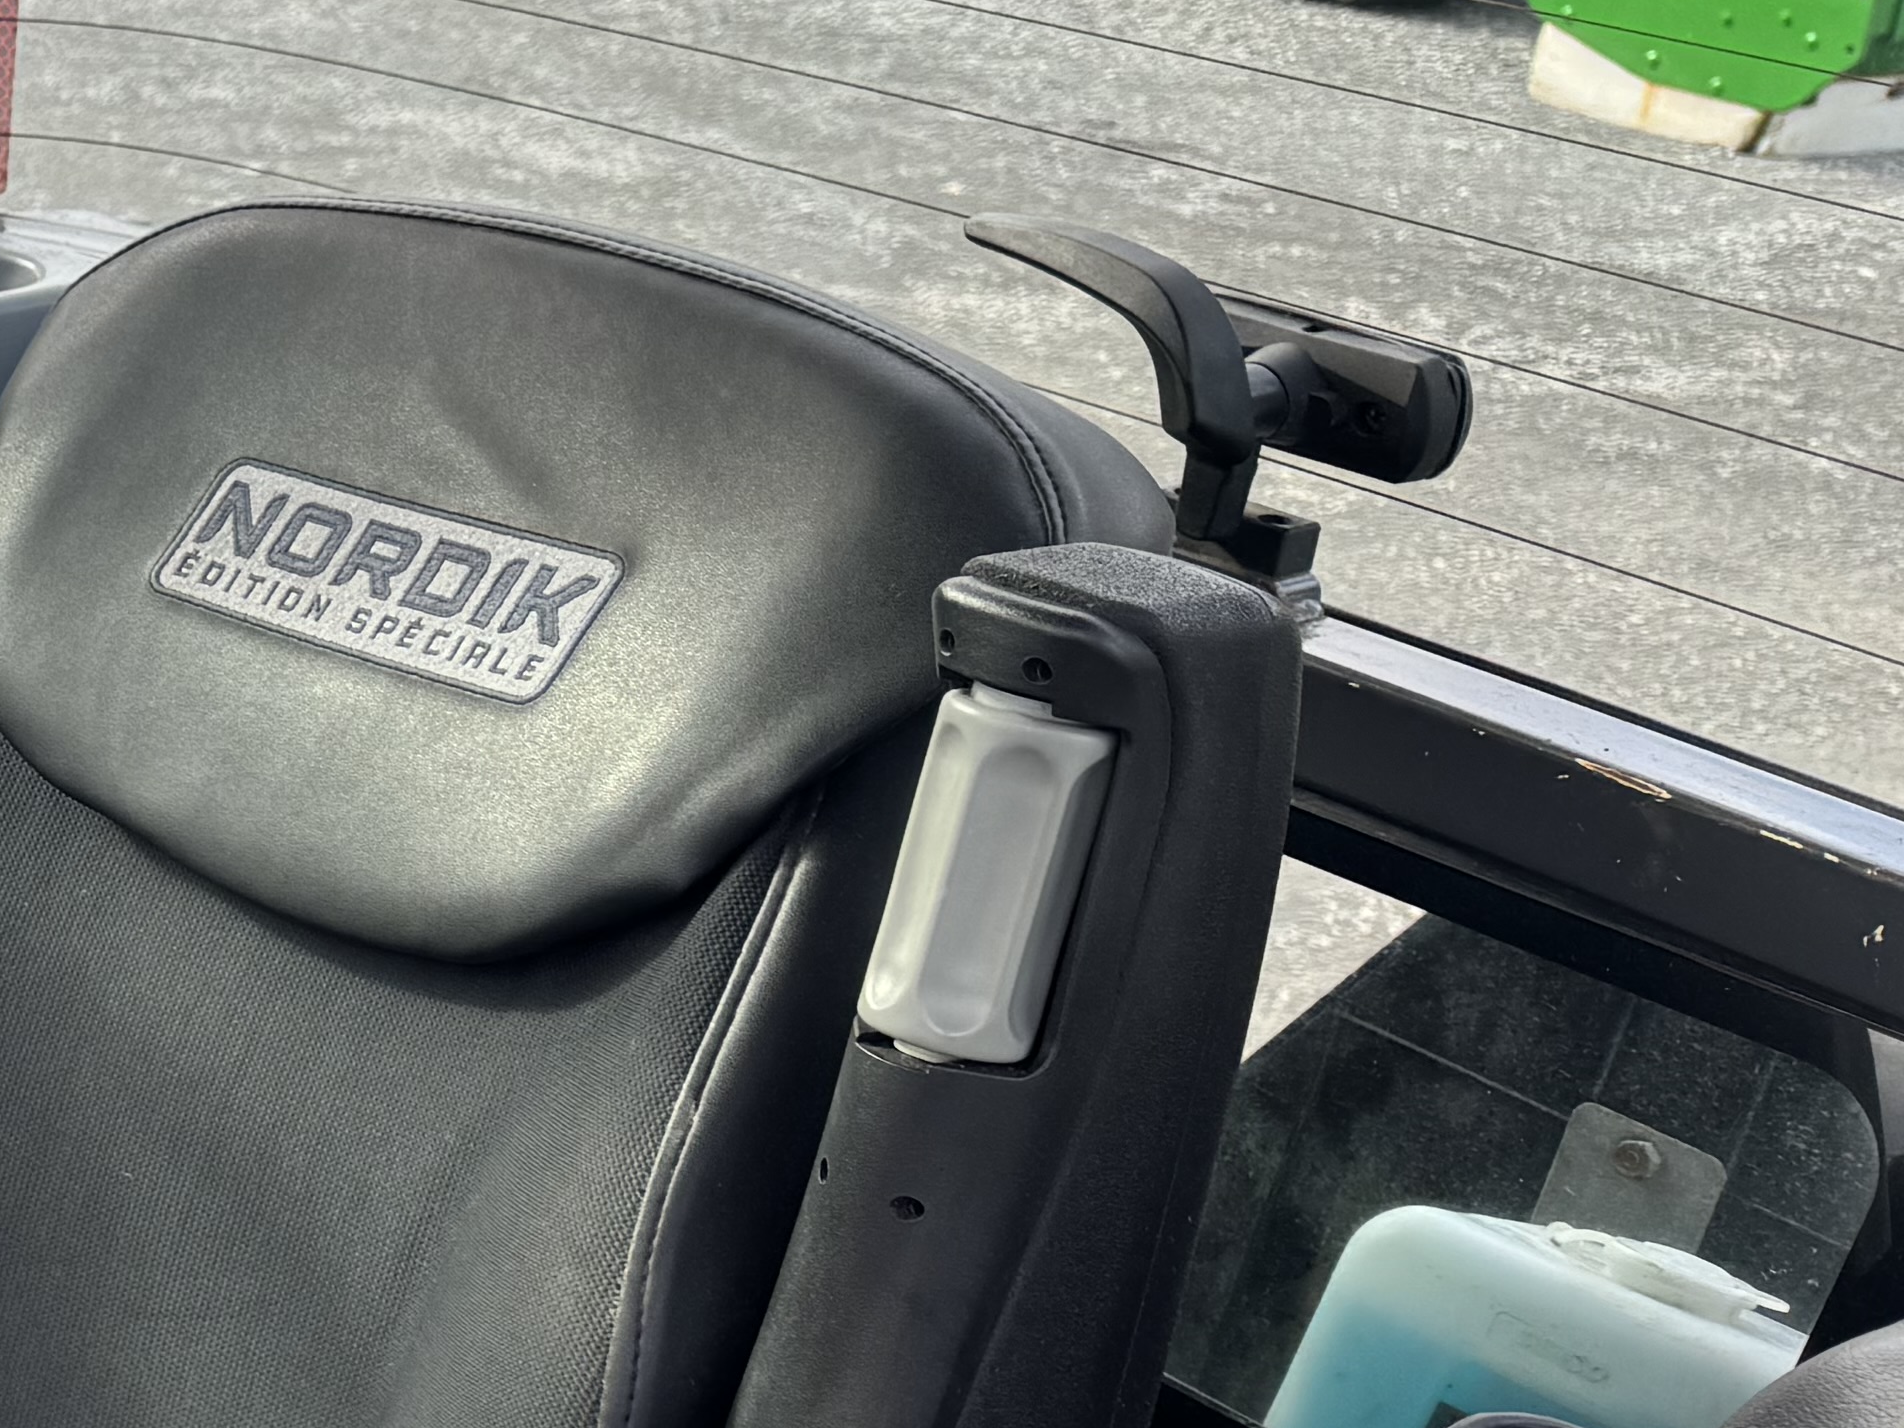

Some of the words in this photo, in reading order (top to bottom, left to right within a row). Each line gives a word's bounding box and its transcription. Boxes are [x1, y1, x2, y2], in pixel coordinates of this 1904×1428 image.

[175, 548, 331, 621] ÉDITION
[344, 608, 547, 682] SPÉCIALE
[195, 480, 600, 647] NORDIK
